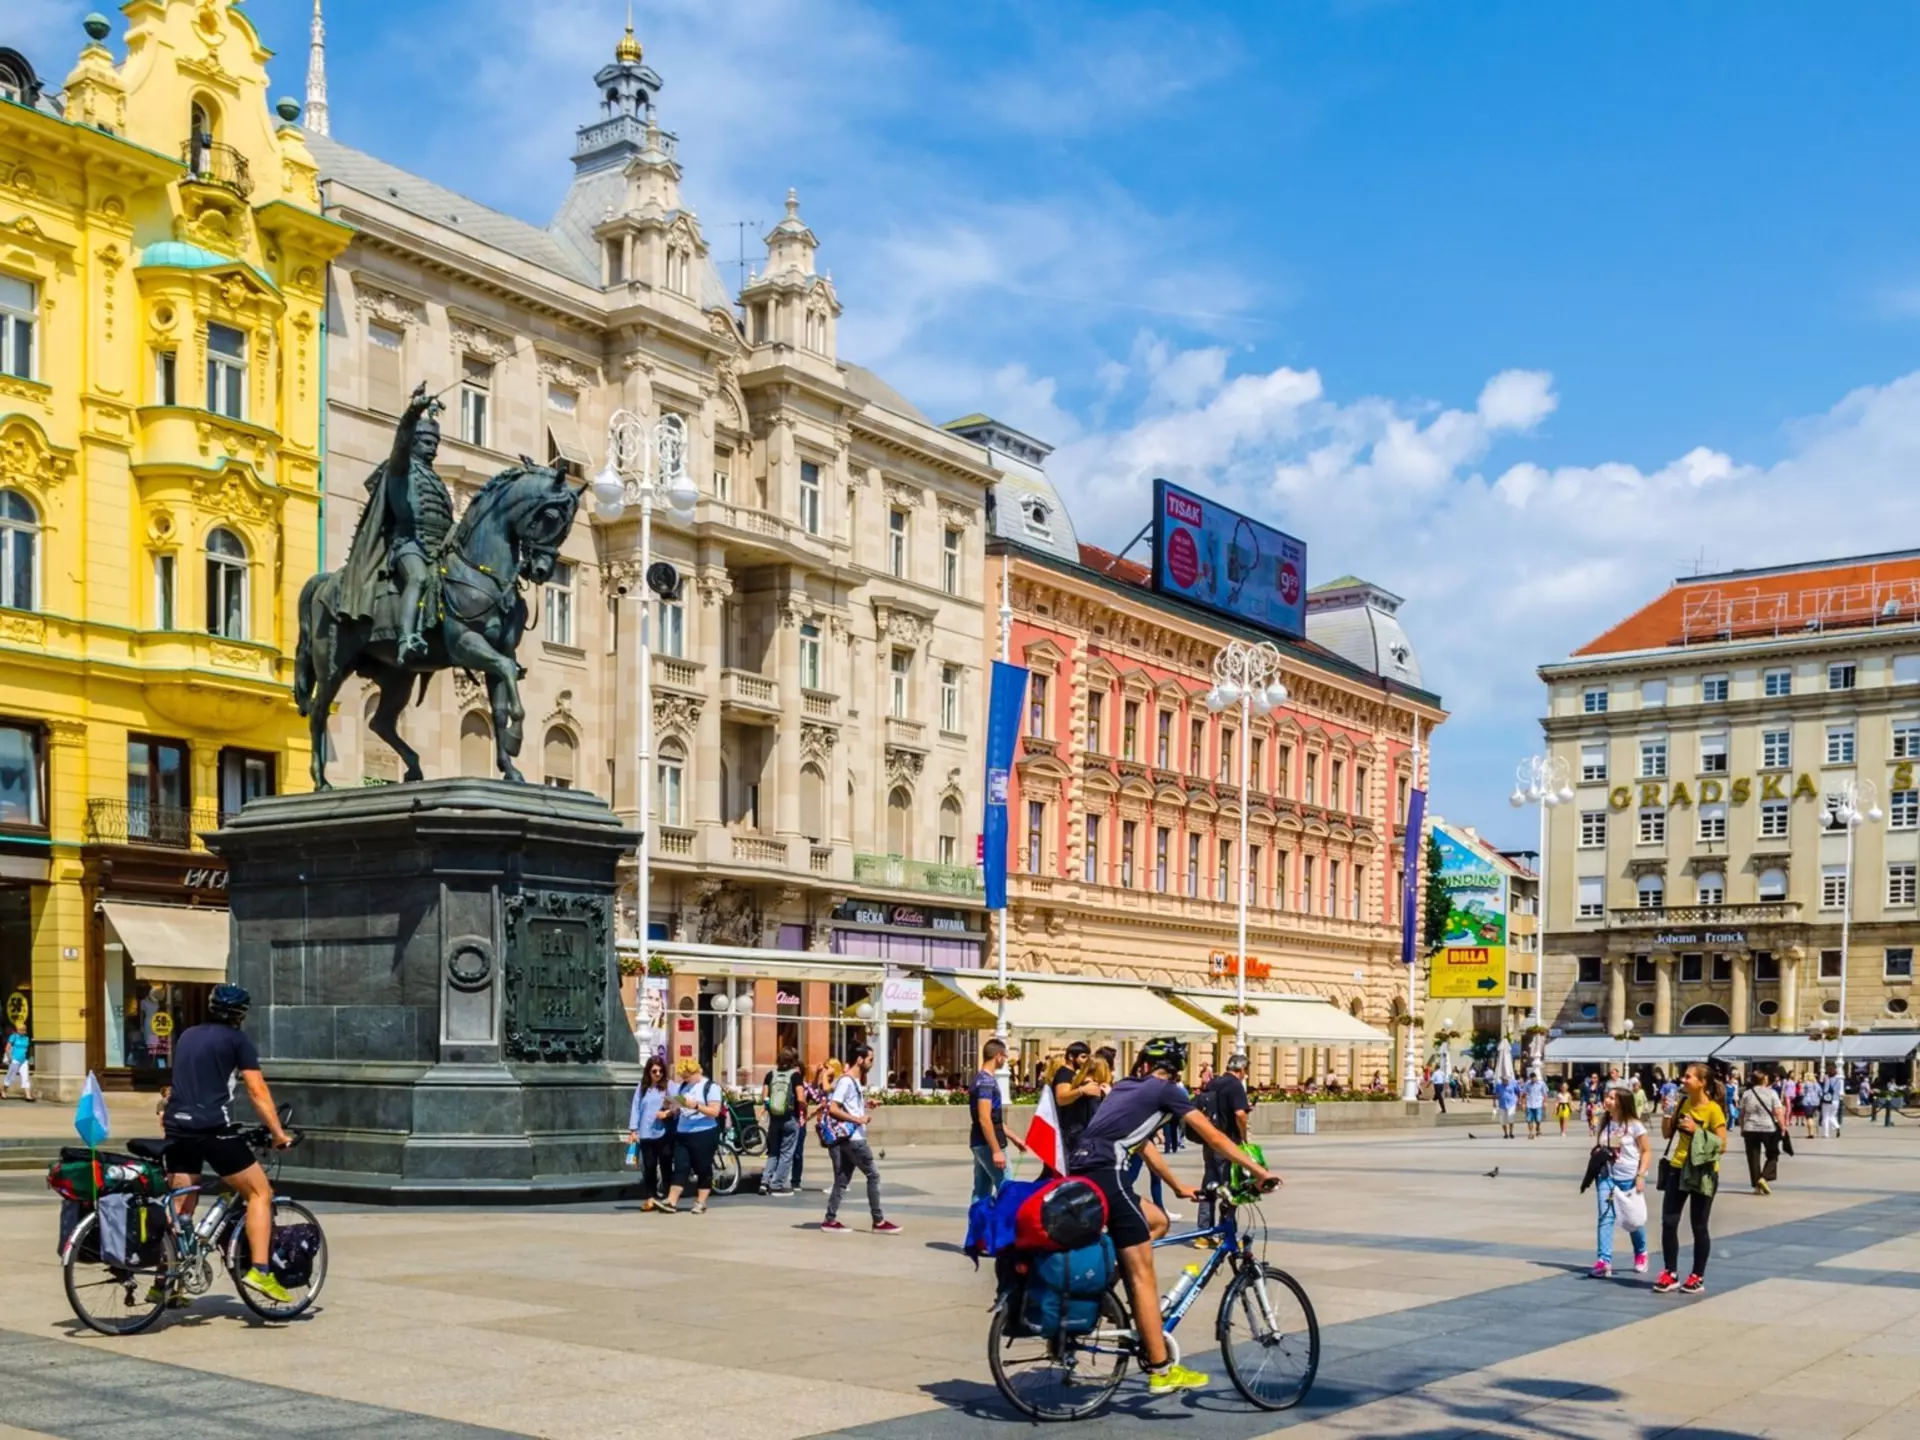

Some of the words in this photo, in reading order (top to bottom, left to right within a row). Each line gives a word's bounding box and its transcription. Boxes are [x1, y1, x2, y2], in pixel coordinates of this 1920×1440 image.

[1168, 496, 1200, 524] TISAK
[1609, 772, 1818, 811] GRADSKA
[855, 908, 885, 925] BEČKA
[893, 906, 924, 923] Aida
[932, 917, 966, 932] KAVANA
[541, 933, 574, 956] BAN
[1654, 933, 1697, 944] Johann
[1704, 931, 1745, 944] Franck
[1449, 949, 1487, 963] BILLA
[776, 991, 800, 1005] Aida
[885, 982, 920, 1001] Aida
